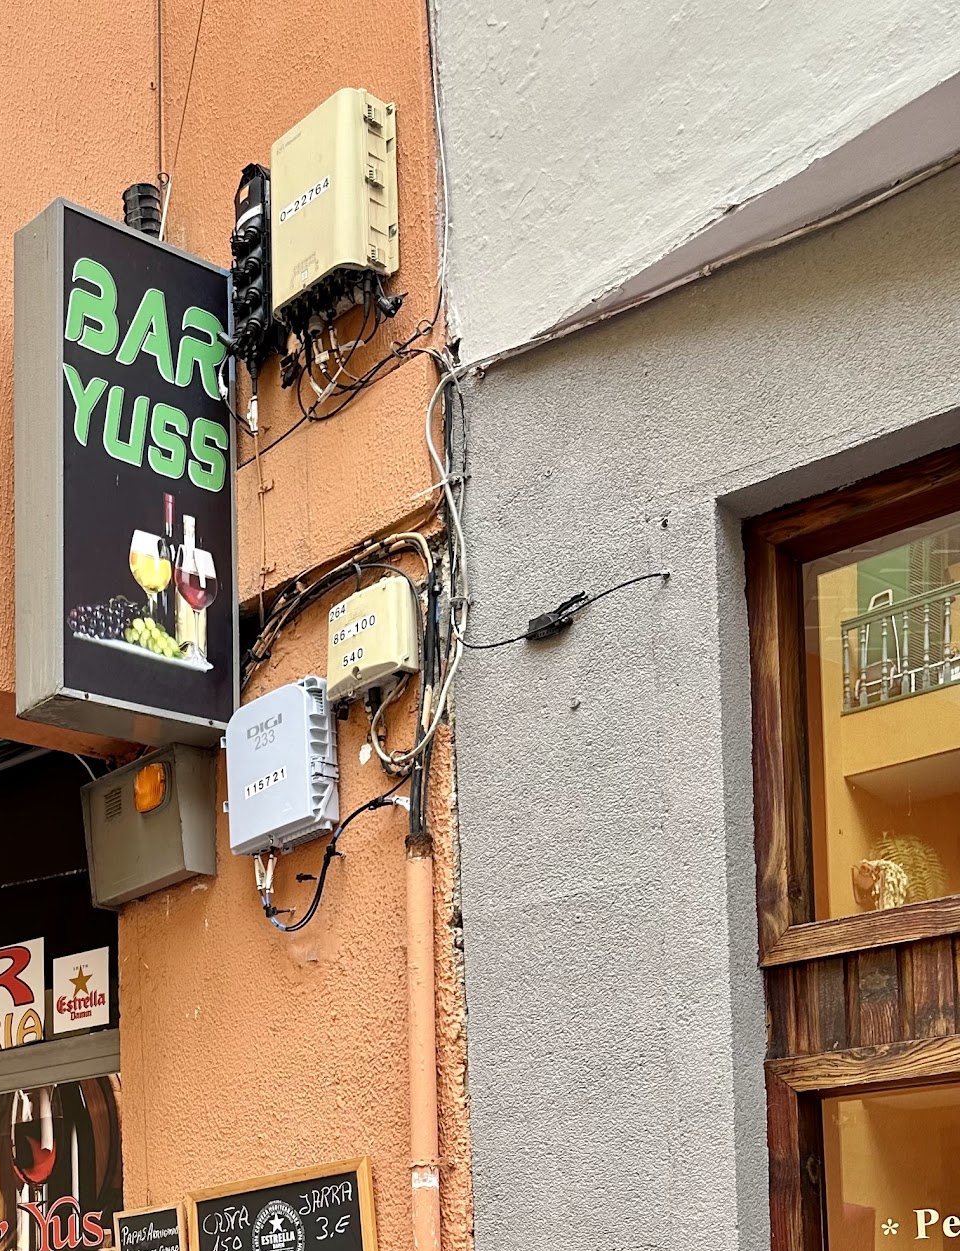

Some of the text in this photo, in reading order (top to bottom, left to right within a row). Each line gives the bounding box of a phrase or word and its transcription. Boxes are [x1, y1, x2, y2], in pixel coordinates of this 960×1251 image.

[64, 257, 231, 402] BAR
[63, 362, 229, 493] YUSS
[329, 604, 346, 622] 264
[342, 647, 364, 667] 540
[246, 713, 283, 739] DIGI
[254, 730, 276, 751] 233
[246, 768, 286, 797] 115721
[56, 989, 106, 1015] Estrella
[70, 1010, 92, 1021] Damm
[299, 1181, 353, 1215] JARRA
[122, 1225, 147, 1246] PAPAS
[261, 1231, 296, 1245] ESTRELLA
